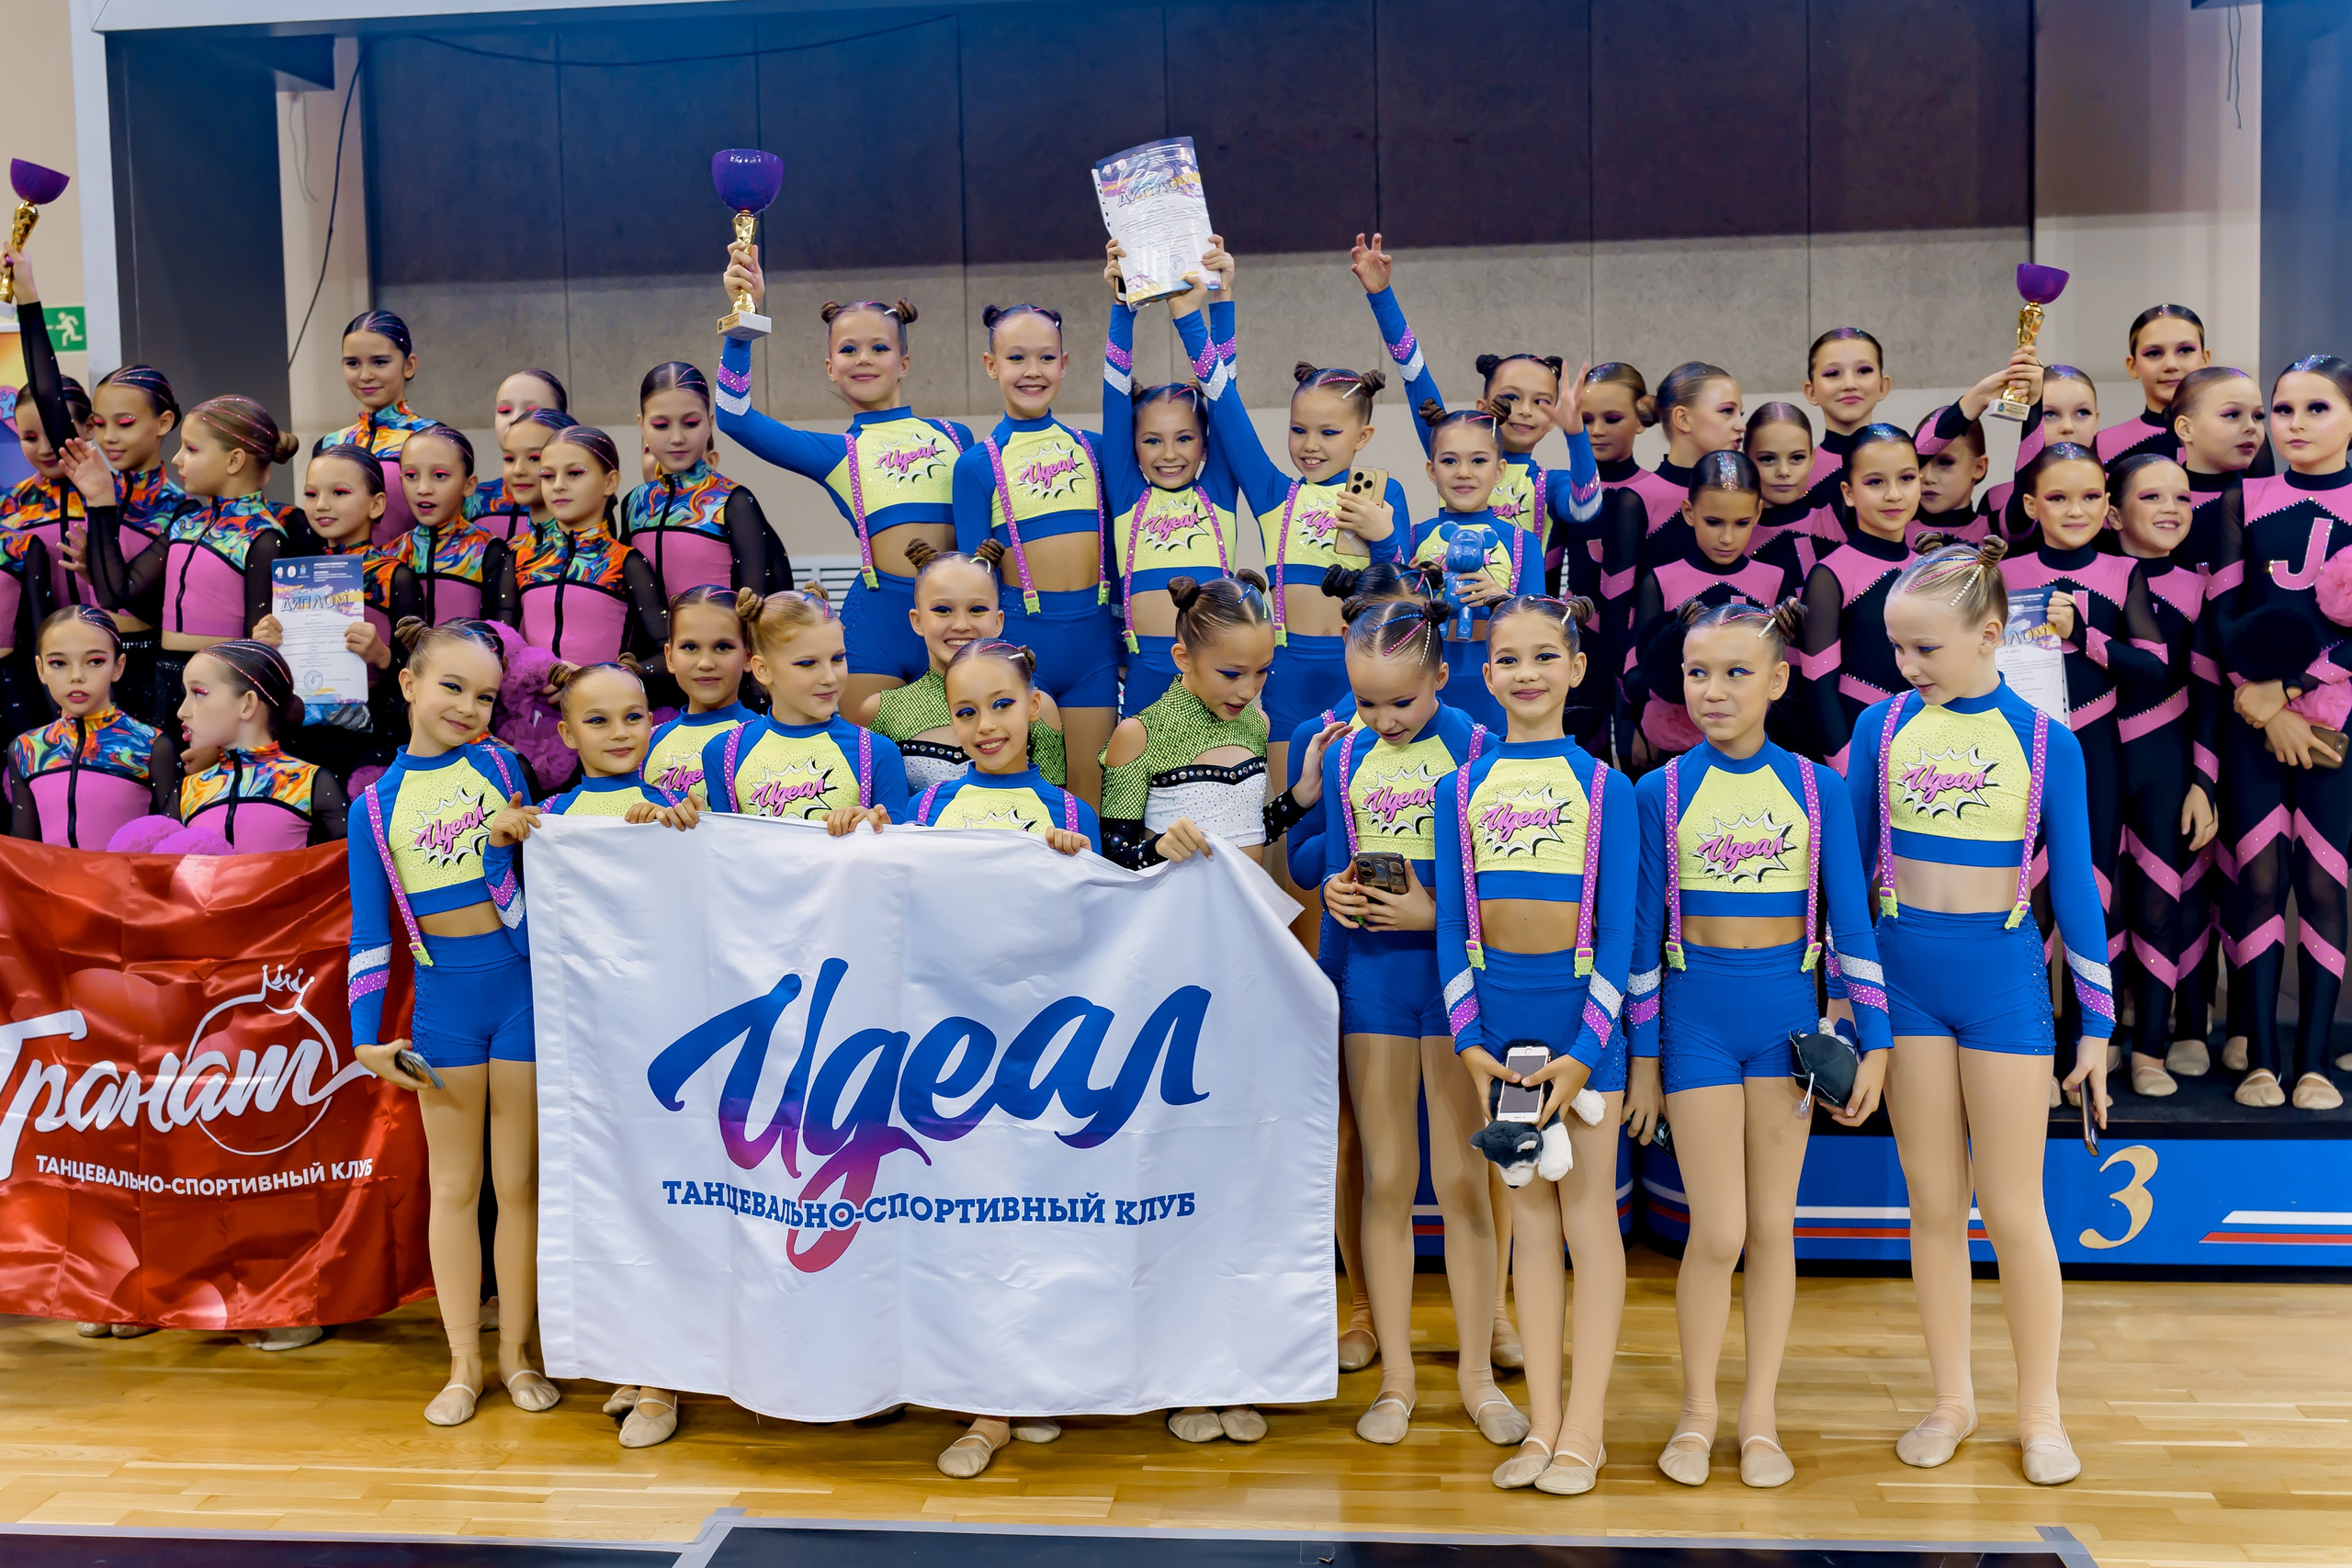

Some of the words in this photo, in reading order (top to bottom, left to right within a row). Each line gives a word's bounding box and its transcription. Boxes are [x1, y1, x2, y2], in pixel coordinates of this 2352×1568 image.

[1117, 176, 1190, 208] ДЛО
[876, 445, 937, 474] Идеал
[1020, 457, 1079, 489] Идеал
[1143, 512, 1202, 541] Идеал
[1492, 502, 1521, 520] еал
[281, 594, 349, 613] ДИПЛОМ
[2002, 627, 2048, 646] ЛОМ
[659, 764, 705, 794] Иде
[752, 778, 827, 817] Идеал
[1901, 764, 1986, 803] Идеал
[415, 805, 487, 854] Идеал
[1480, 803, 1560, 842] Идеал
[1698, 833, 1785, 873] Идеал
[647, 957, 1212, 1274] Идеал
[36, 1154, 326, 1196] ТАНЦЕВАЛЬНО-СПОРТИВНЫЙ
[331, 1157, 374, 1179] КЛУБ
[662, 1180, 1105, 1229] ТАНЦЕВАЛЬНО-СПОРТИВНЫЙ
[1114, 1191, 1196, 1225] КЛУБ
[2078, 1145, 2159, 1249] 3
